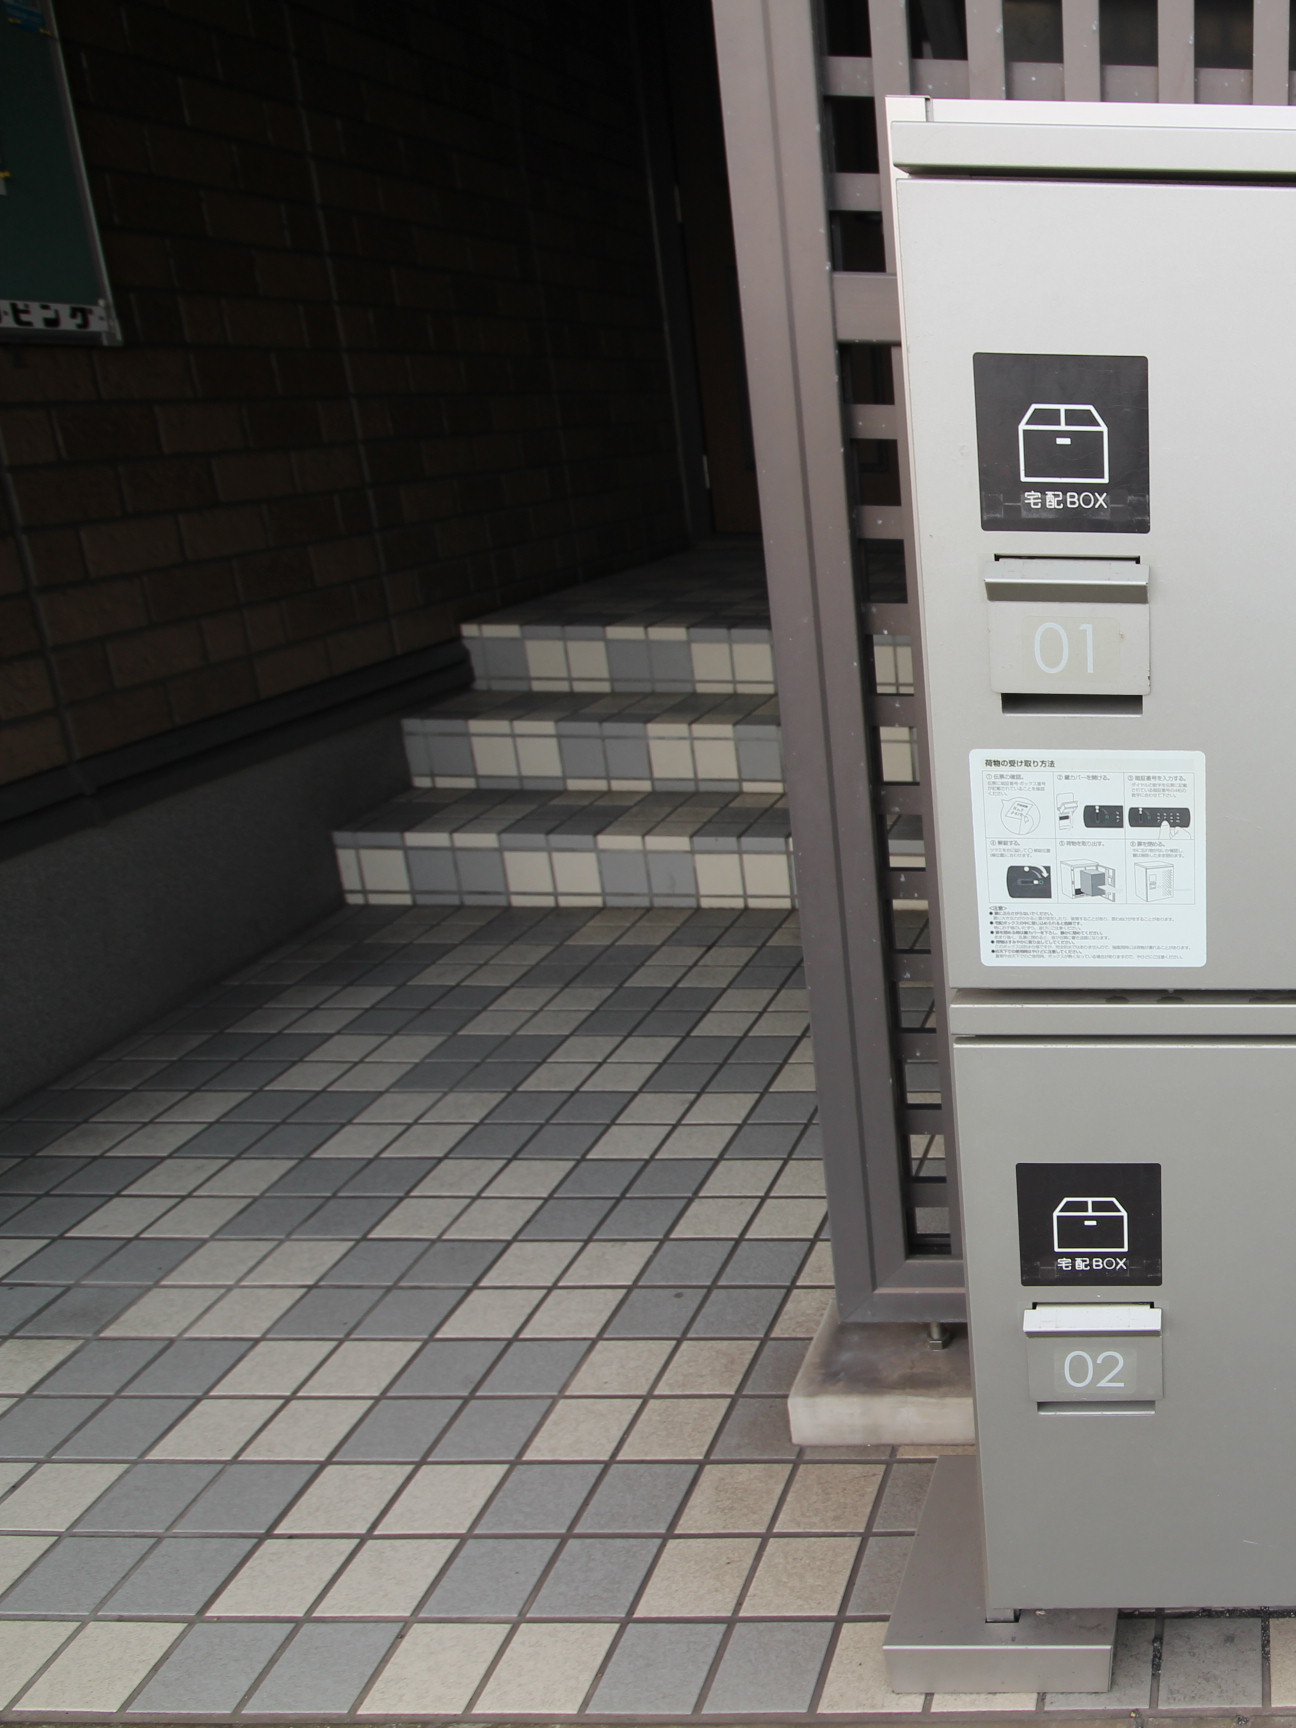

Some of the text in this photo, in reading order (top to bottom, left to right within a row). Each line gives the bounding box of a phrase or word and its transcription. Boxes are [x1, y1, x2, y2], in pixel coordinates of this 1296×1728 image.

[0, 301, 93, 329] ピング
[1024, 490, 1108, 509] 宅配BOX
[1033, 622, 1095, 674] 01
[984, 758, 1056, 768] 荷物の受け取り方法
[1056, 1257, 1128, 1271] 宅配BOX
[1063, 1350, 1126, 1388] 02
